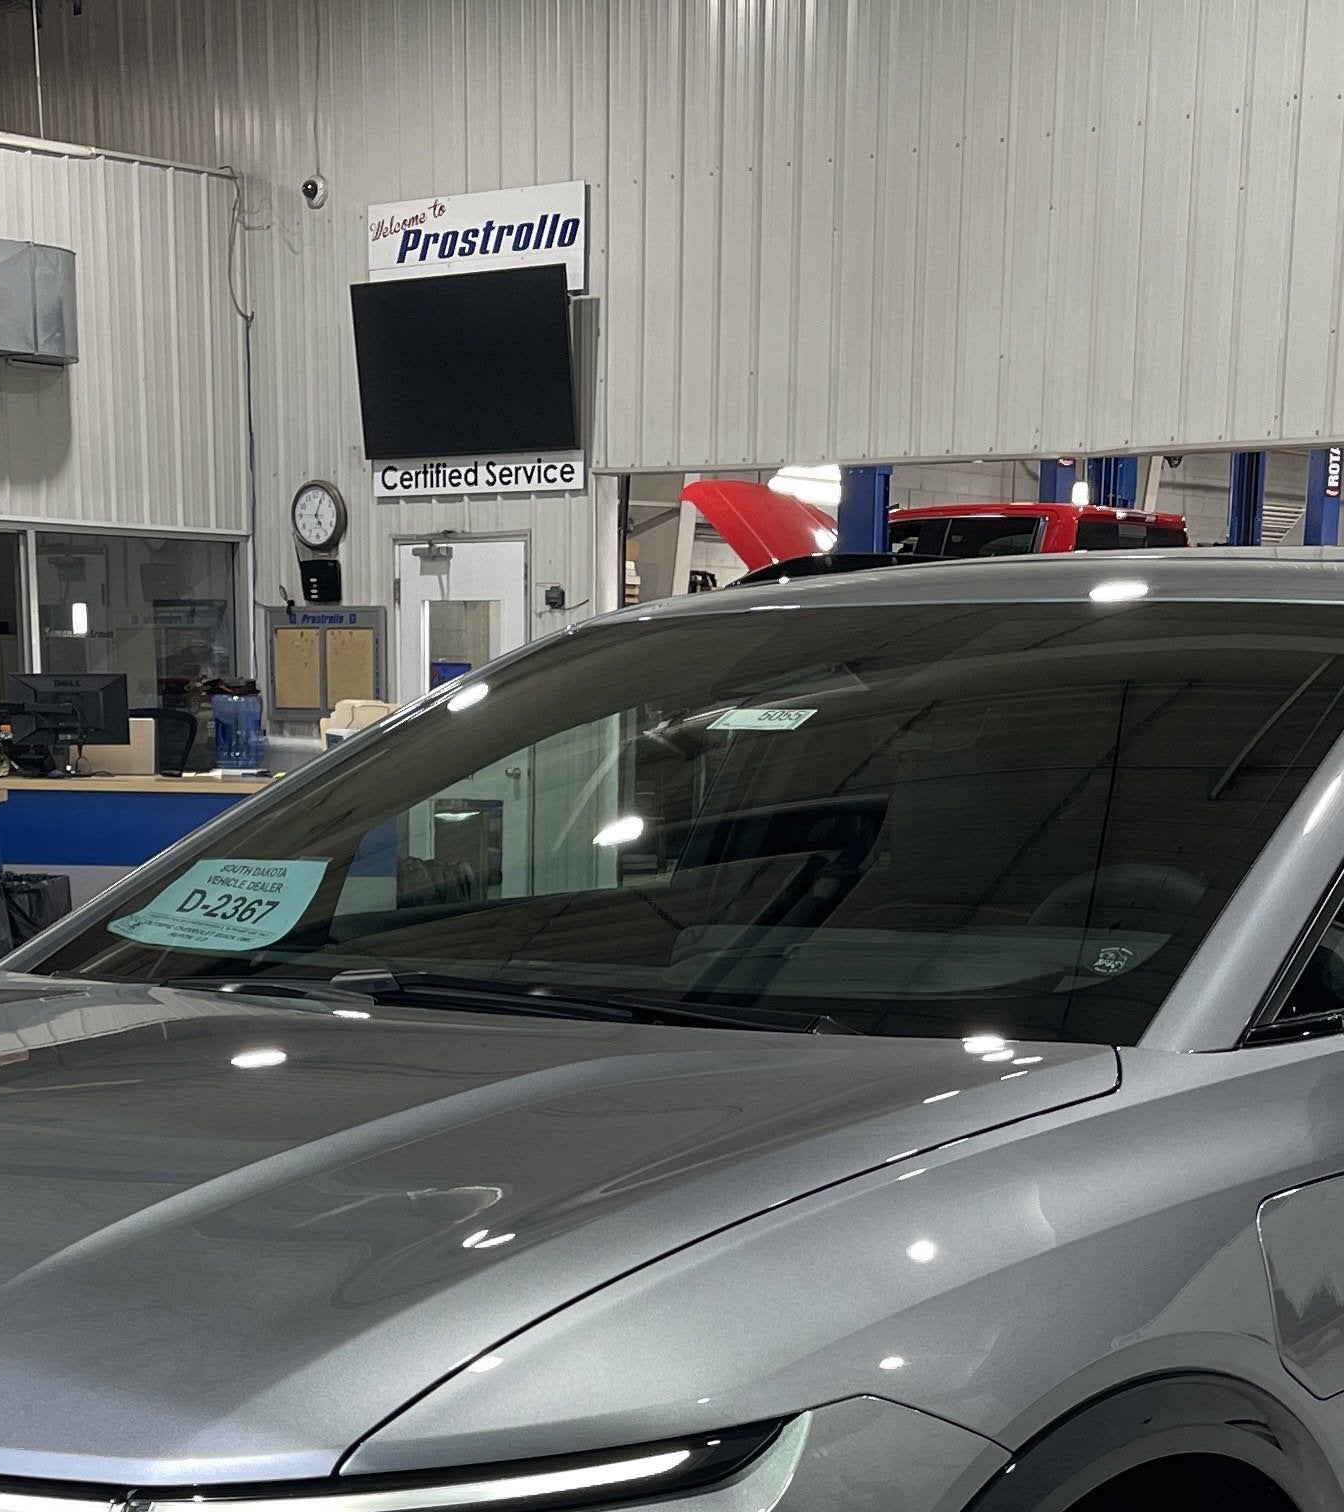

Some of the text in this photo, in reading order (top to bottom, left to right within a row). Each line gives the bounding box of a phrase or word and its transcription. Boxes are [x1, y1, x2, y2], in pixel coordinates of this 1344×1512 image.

[370, 199, 446, 242] Welcome to
[396, 213, 581, 264] Prostrollo
[381, 457, 575, 491] Certified Service
[1327, 447, 1342, 487] ROTA
[54, 679, 81, 688] DELL
[207, 875, 284, 894] VEHICLE DEALER
[220, 864, 287, 878] SOUTH DAKOTA
[176, 888, 281, 925] D-2367
